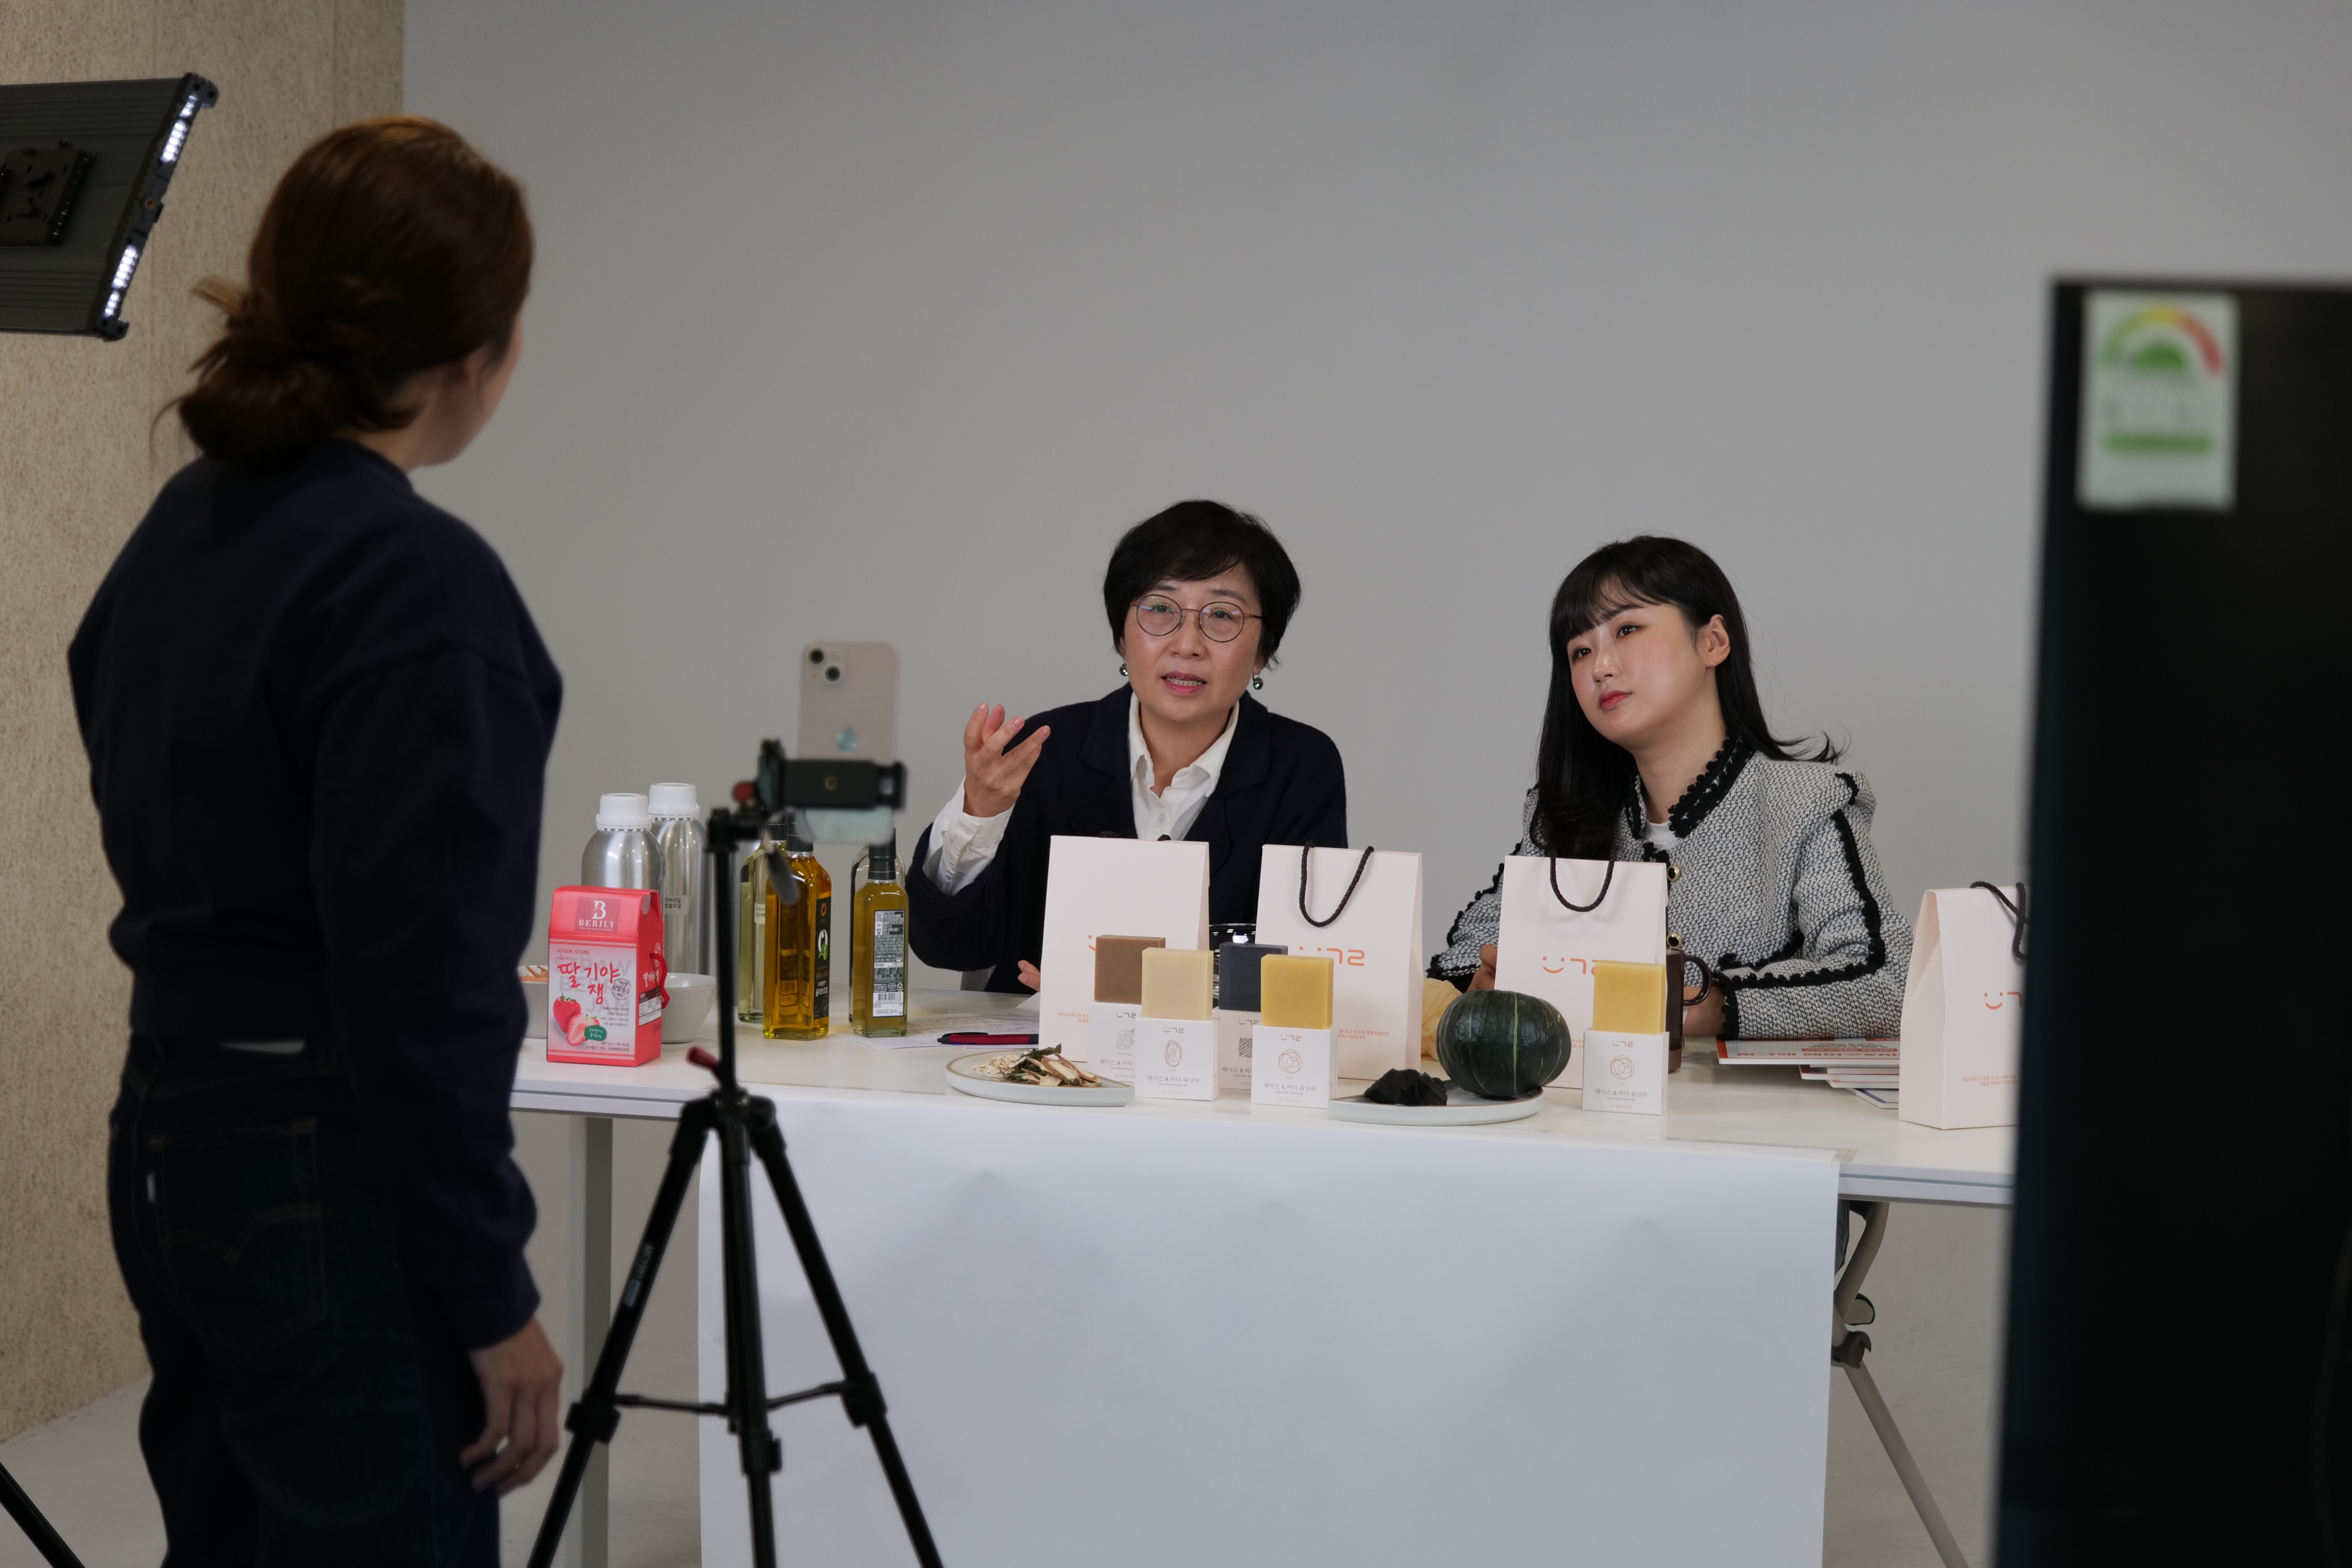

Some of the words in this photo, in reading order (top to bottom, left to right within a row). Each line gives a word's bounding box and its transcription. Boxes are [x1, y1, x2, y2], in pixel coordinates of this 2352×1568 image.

[579, 919, 615, 928] BERILY
[557, 961, 621, 988] 딸기야
[612, 984, 630, 994] 사탕수수
